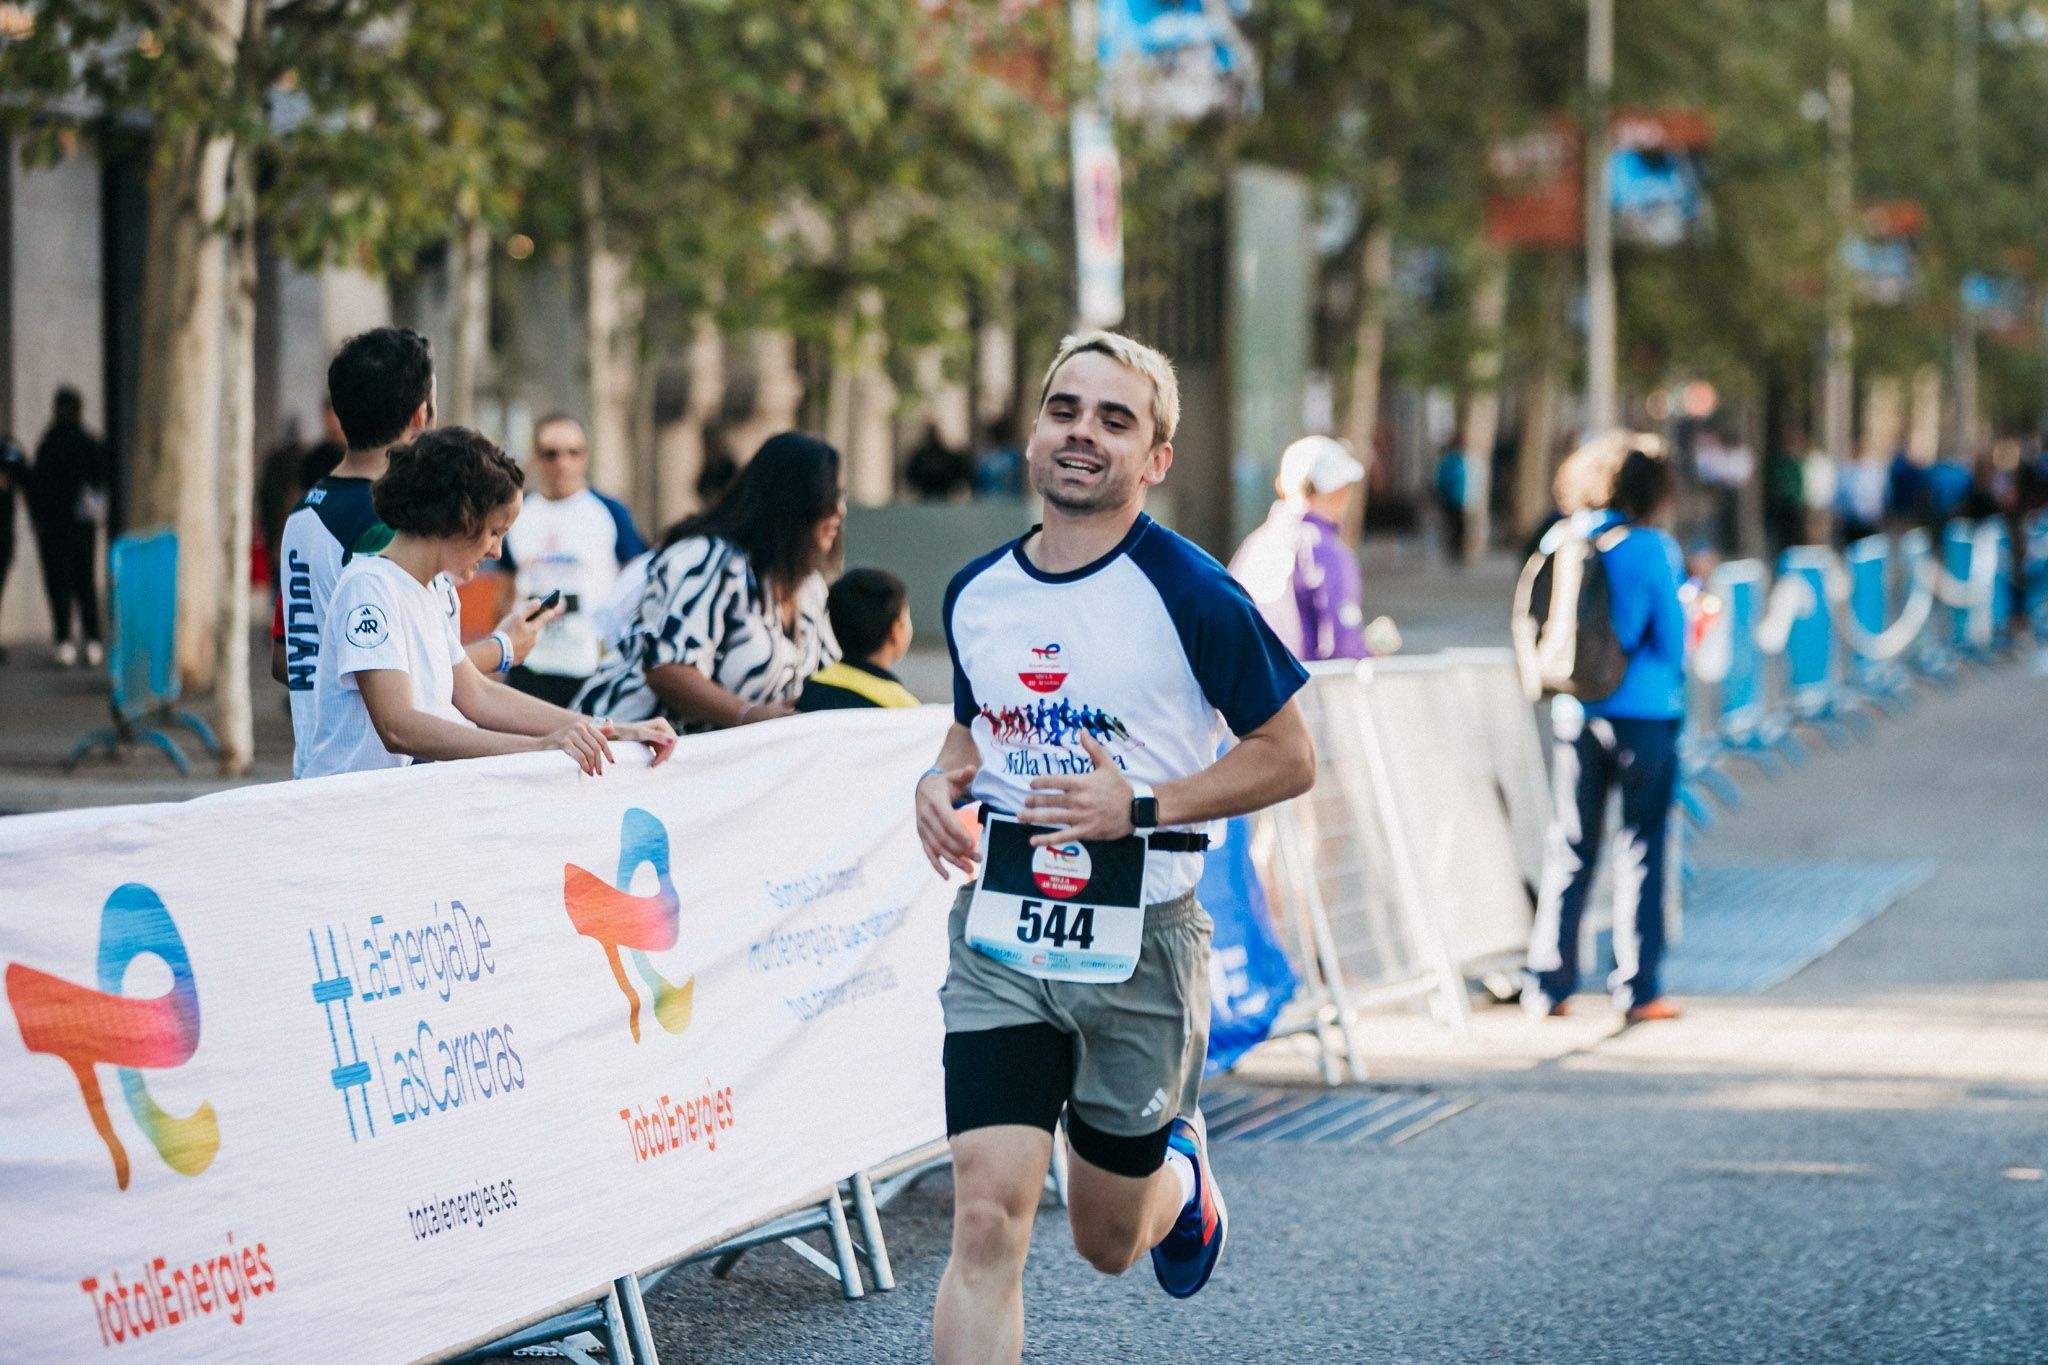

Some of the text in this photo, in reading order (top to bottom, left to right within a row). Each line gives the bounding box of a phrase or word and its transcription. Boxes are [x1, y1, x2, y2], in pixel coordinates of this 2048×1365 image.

[288, 549, 319, 691] JULIAN
[1016, 899, 1095, 949] 544
[371, 1020, 526, 1125] LasCarreras
[619, 1076, 734, 1164] TotalEnergies
[406, 1178, 519, 1241] totalenergies.es
[79, 1230, 276, 1348] TotalEnergies
